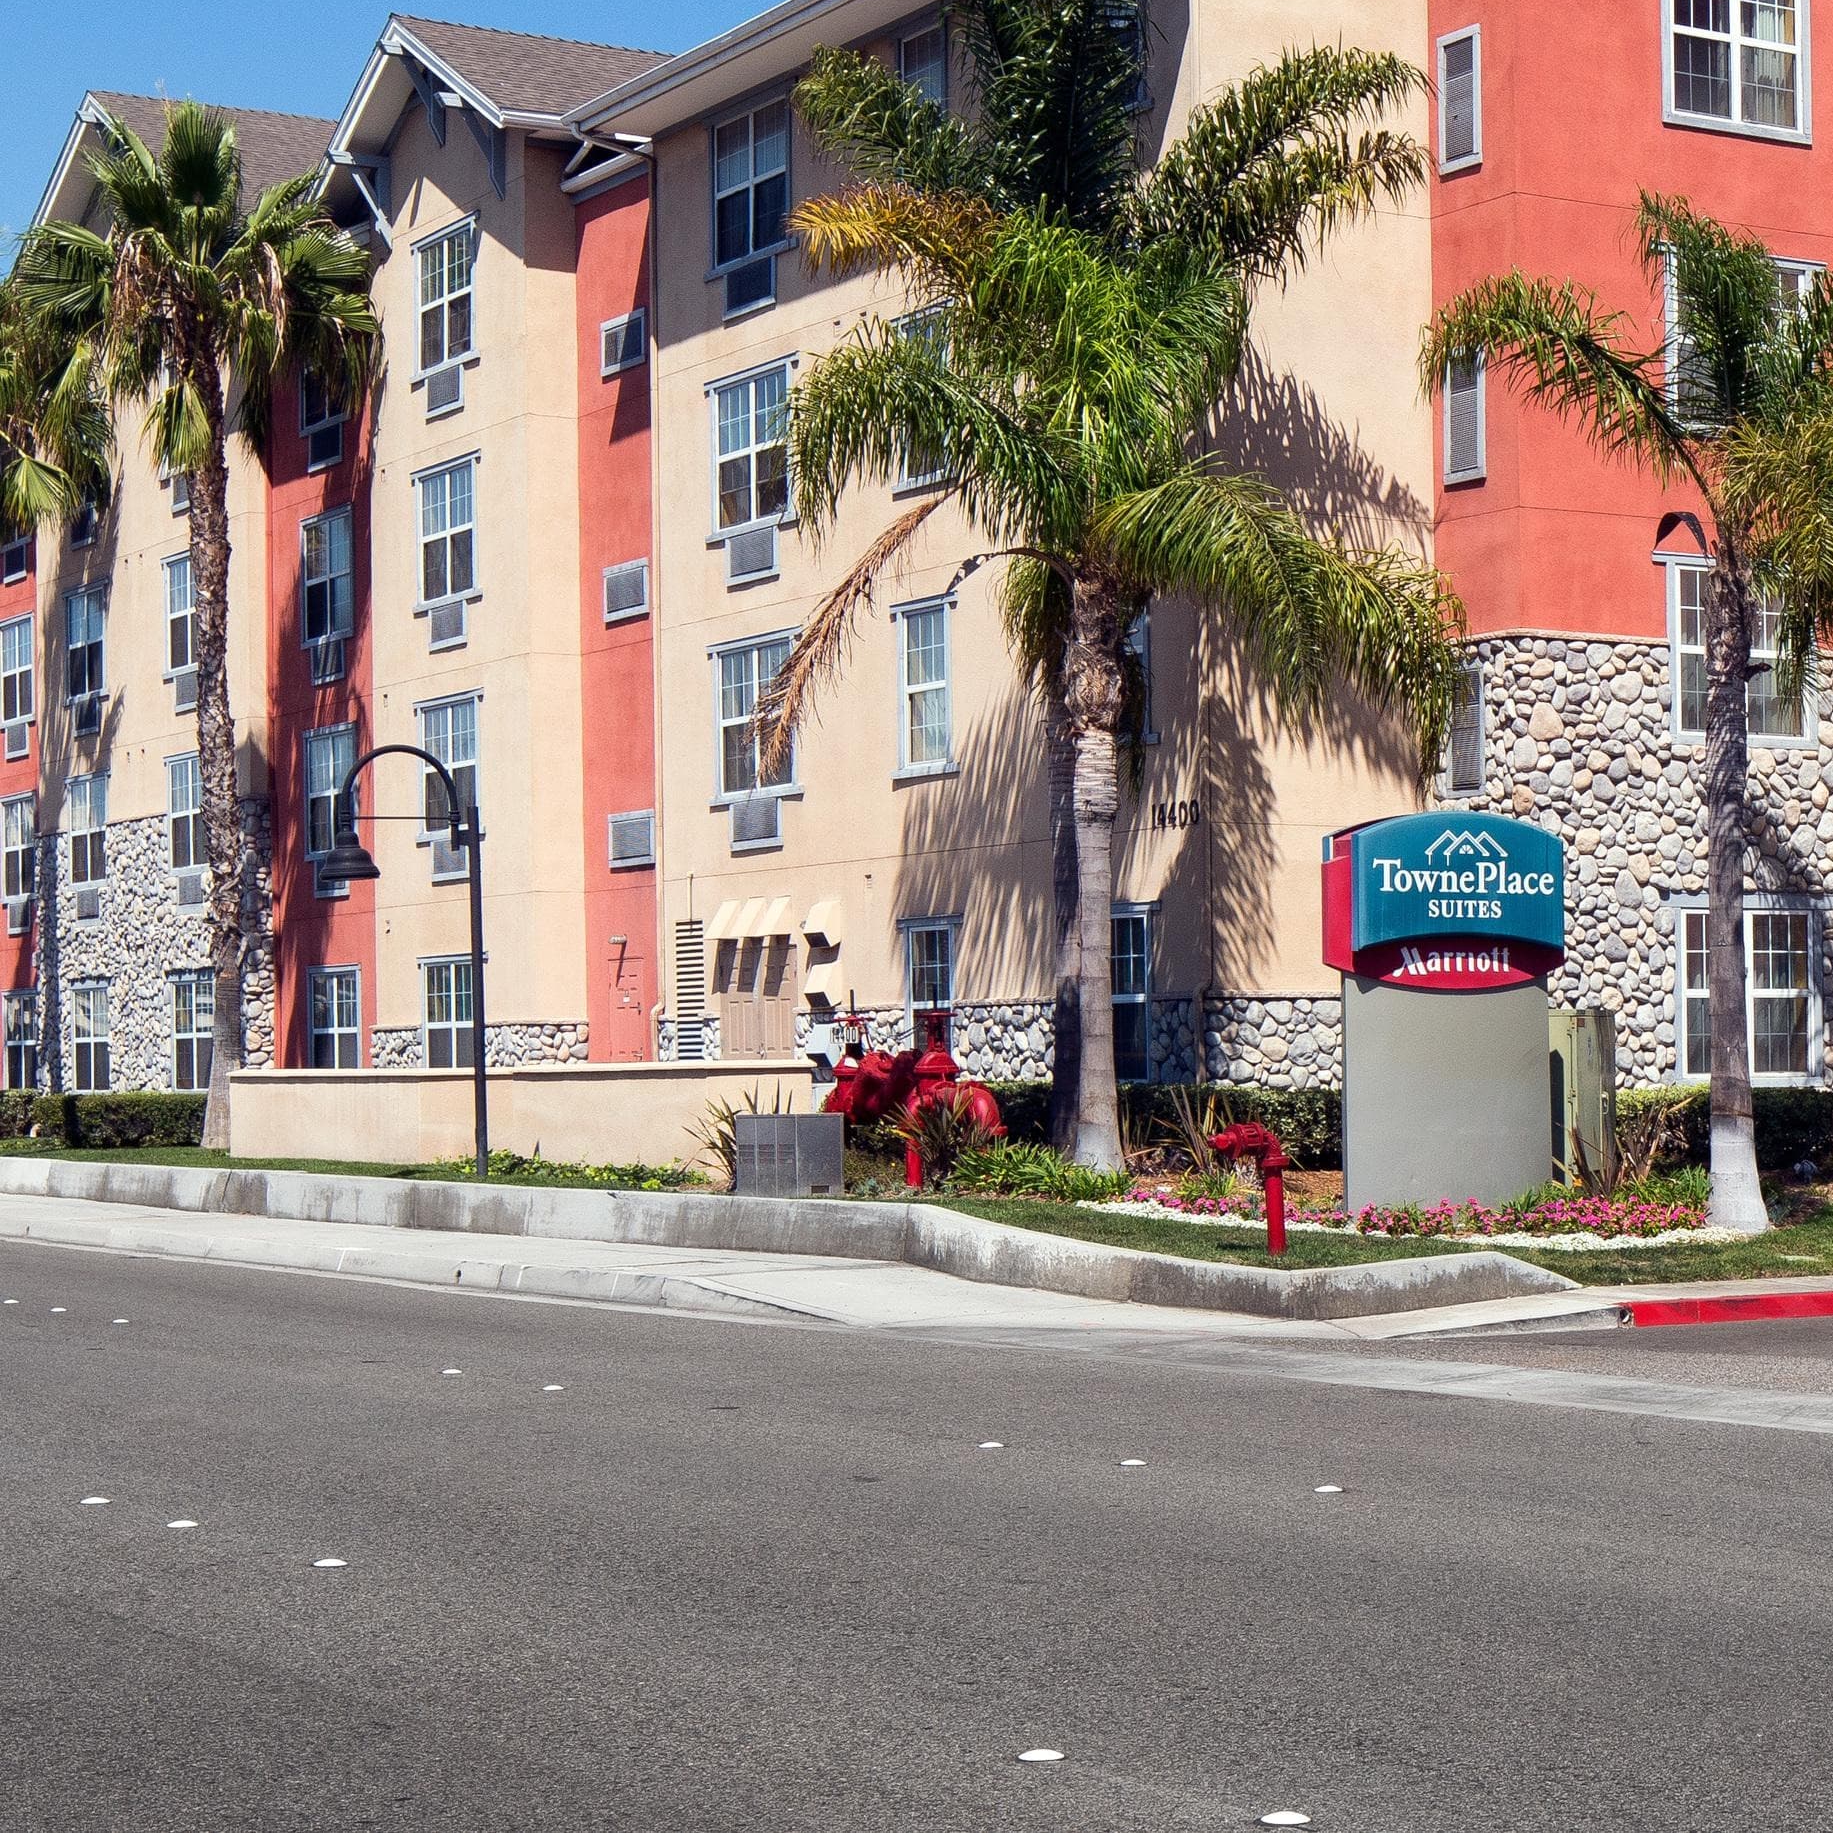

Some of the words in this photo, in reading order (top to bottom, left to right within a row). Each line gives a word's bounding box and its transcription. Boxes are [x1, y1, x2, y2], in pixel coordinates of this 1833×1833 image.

[1151, 799, 1199, 832] 14400
[1372, 858, 1555, 895] TownePlace
[1428, 899, 1502, 918] SUITES
[1392, 946, 1511, 978] Marriott
